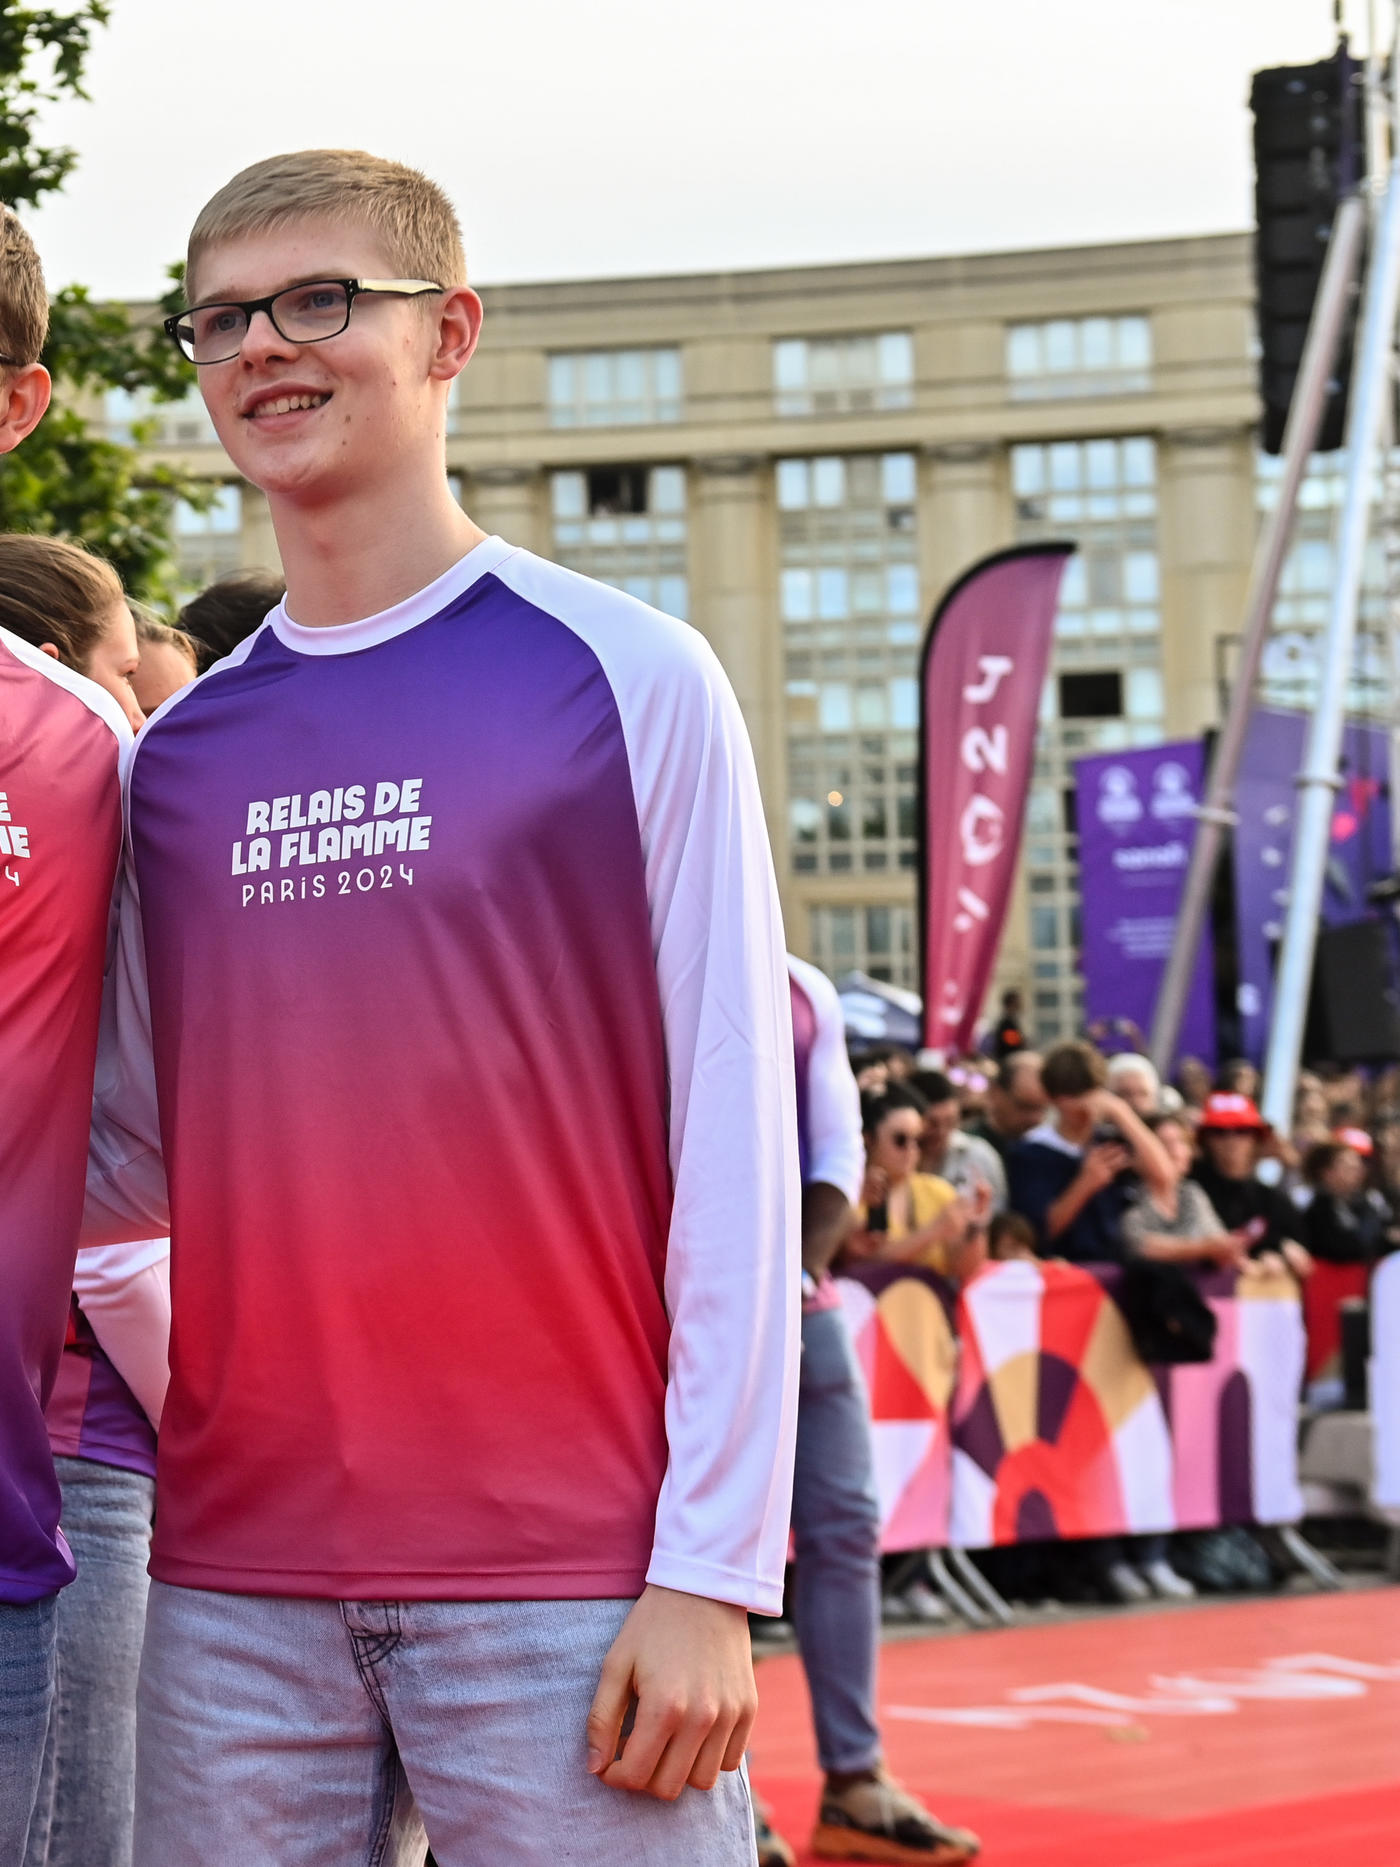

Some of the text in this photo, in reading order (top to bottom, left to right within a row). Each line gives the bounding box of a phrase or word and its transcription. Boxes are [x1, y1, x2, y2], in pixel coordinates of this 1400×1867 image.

[246, 778, 423, 835] RELAIS DE
[231, 816, 433, 876] LA FLAMME
[337, 863, 414, 895] 2024
